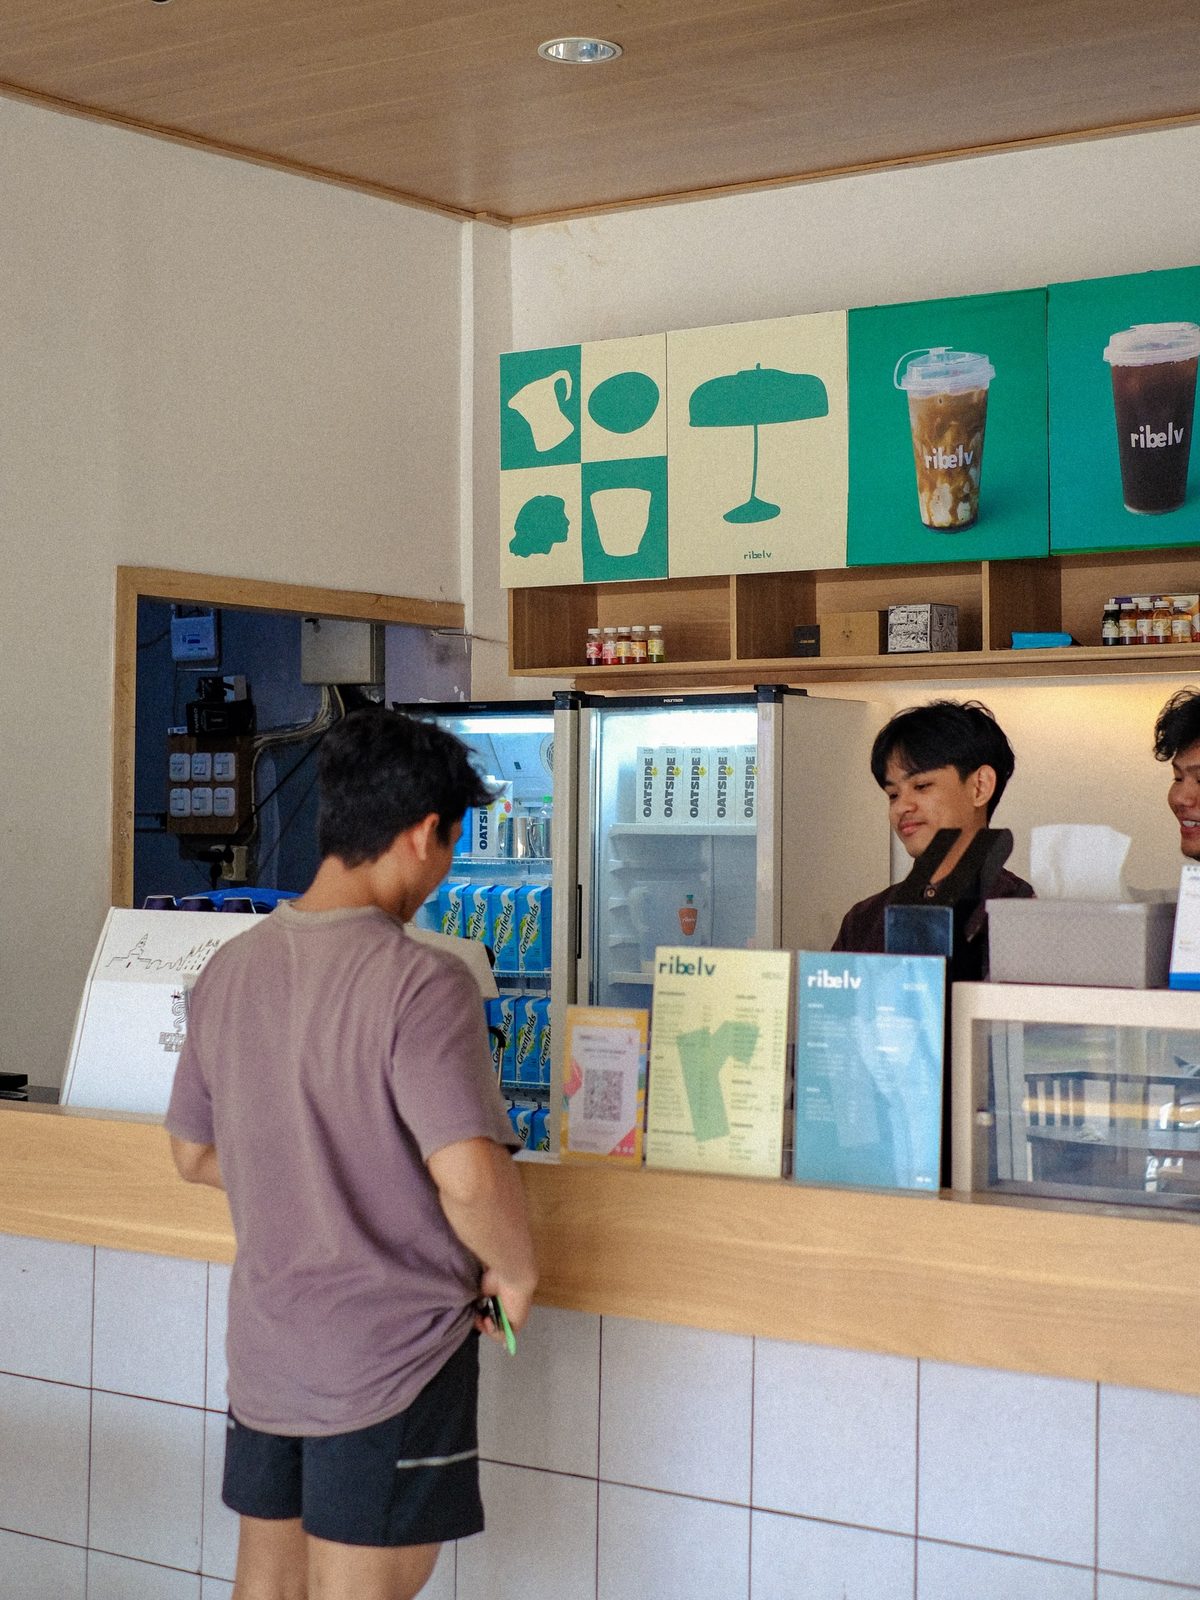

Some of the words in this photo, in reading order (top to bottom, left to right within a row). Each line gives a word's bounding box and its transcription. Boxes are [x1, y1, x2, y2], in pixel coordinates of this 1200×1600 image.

[924, 444, 974, 470] ribelv
[1130, 422, 1184, 449] ribelv
[743, 550, 772, 560] ribelv
[643, 757, 654, 818] OATSIDE
[664, 757, 676, 818] OATSIDE
[690, 756, 701, 818] OATSIDE
[717, 756, 728, 818] OATSIDE
[744, 756, 756, 818] OATSIDE
[479, 809, 488, 850] OATSI
[446, 900, 460, 935] enfields
[471, 902, 486, 938] enfields
[494, 903, 513, 954] Greenfields
[520, 903, 539, 954] Greenfields
[658, 956, 717, 976] ribelv
[806, 969, 862, 989] ribelv
[516, 1013, 537, 1065] Greenfields
